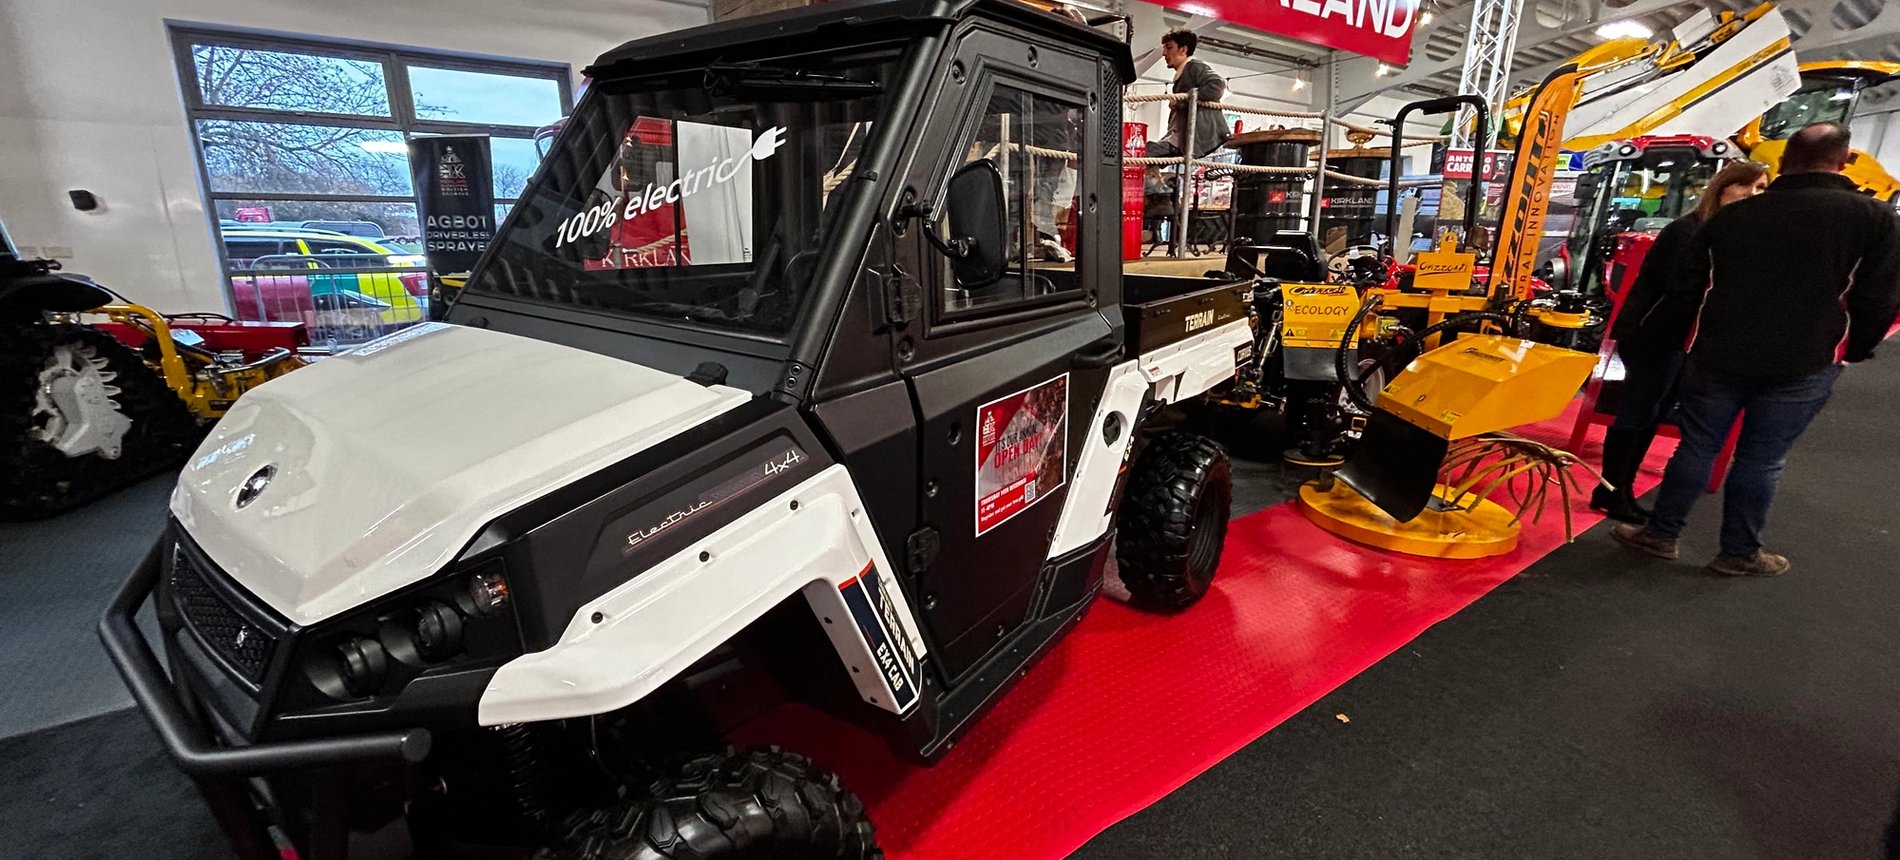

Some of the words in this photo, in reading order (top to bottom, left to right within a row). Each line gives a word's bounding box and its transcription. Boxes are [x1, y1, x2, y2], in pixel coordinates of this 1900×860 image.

[1280, 0, 1419, 38] AND
[1446, 162, 1491, 173] CARRO
[1448, 155, 1492, 163] ANTOO
[556, 197, 619, 248] 100%
[623, 157, 735, 221] electric
[1518, 249, 1535, 294] URAL
[1527, 114, 1561, 237] INNOVATION
[427, 215, 486, 229] AGBOT
[602, 248, 692, 267] KRKLA
[1185, 309, 1214, 332] TERRAIN
[1295, 305, 1349, 316] ECOLOGY
[994, 442, 1019, 468] OPEN
[628, 500, 712, 545] Electric
[764, 450, 800, 475] 4x4
[878, 586, 915, 674] TERRAIN
[876, 641, 892, 669] EX4
[888, 665, 904, 692] CAB
